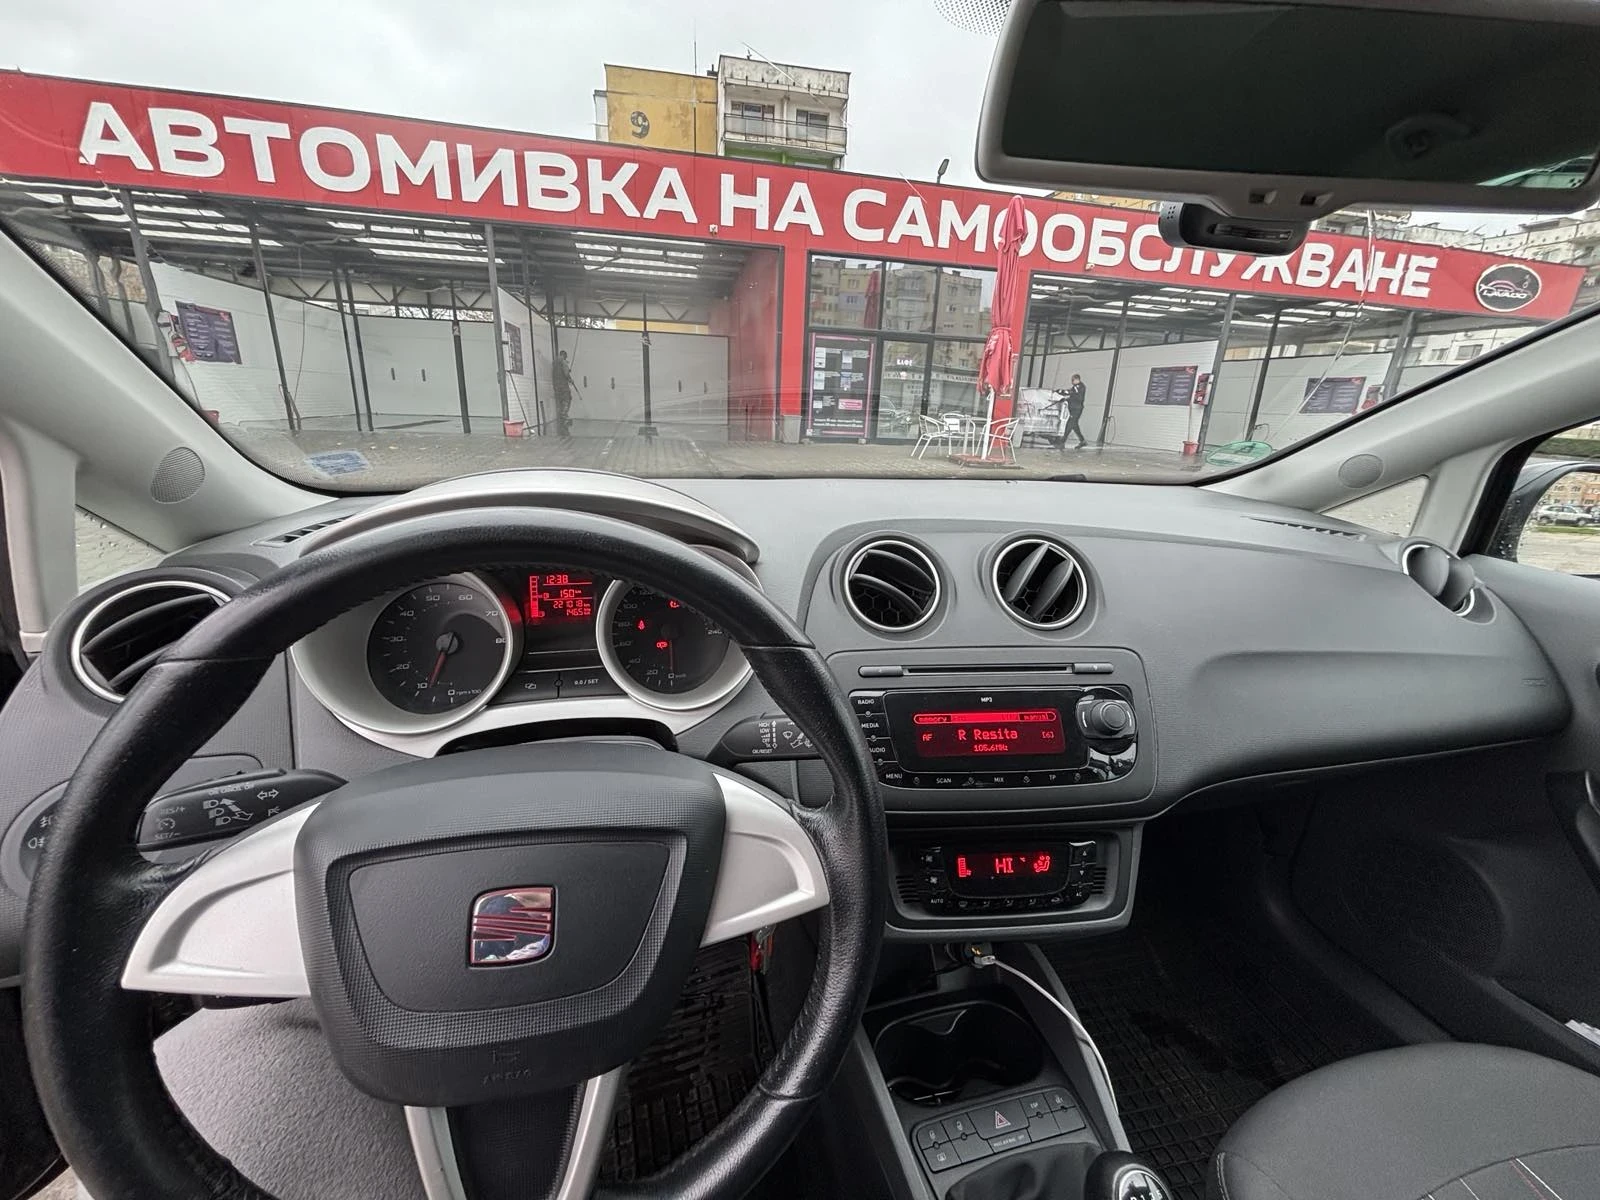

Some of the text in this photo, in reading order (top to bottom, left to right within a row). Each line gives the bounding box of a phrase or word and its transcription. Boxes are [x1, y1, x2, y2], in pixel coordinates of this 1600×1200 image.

[630, 110, 650, 139] 9
[79, 101, 698, 224] АВТОМИВКА
[720, 173, 824, 236] НА
[560, 589, 575, 598] 150
[390, 635, 404, 643] 30
[922, 733, 933, 741] AF
[958, 729, 967, 741] R
[973, 728, 1018, 740] Resita
[994, 776, 1005, 784] MIX
[995, 857, 1014, 874] HI
